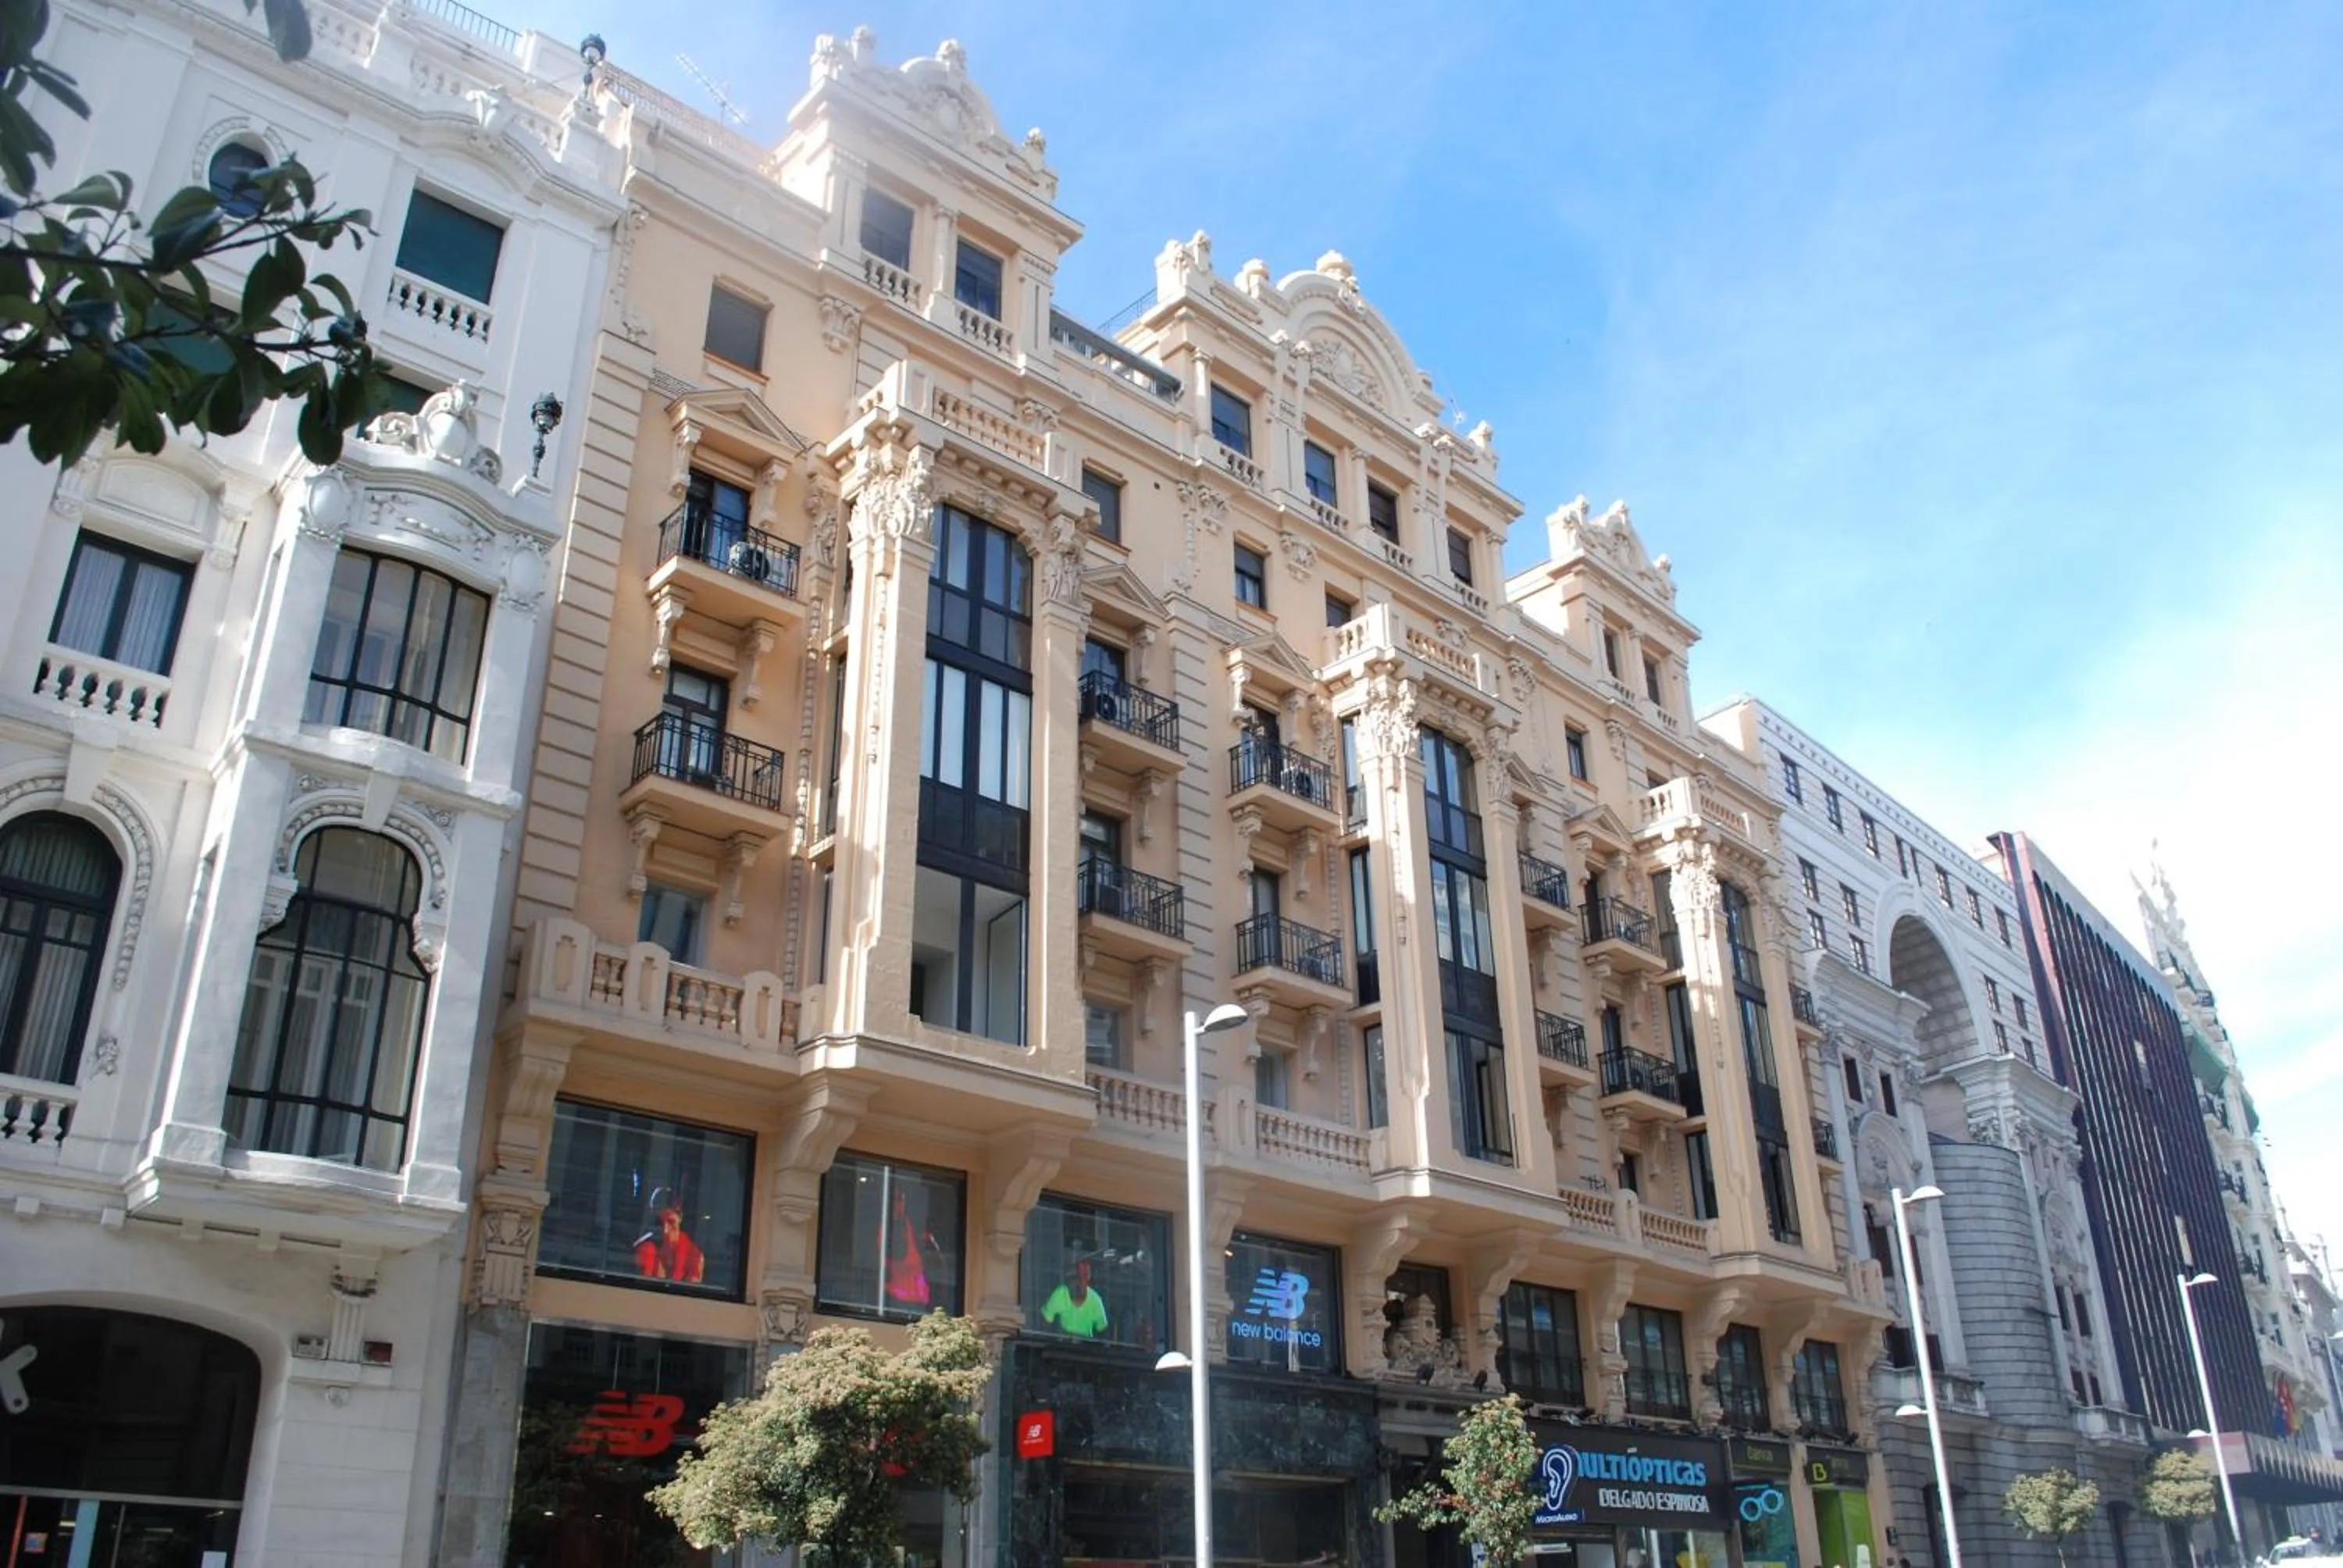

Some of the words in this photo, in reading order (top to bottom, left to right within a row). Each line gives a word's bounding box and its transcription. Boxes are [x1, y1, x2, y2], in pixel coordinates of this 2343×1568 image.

[1232, 1321, 1261, 1338] new
[1599, 1488, 1654, 1509] DELGADO
[1657, 1491, 1709, 1513] ESPINOSA
